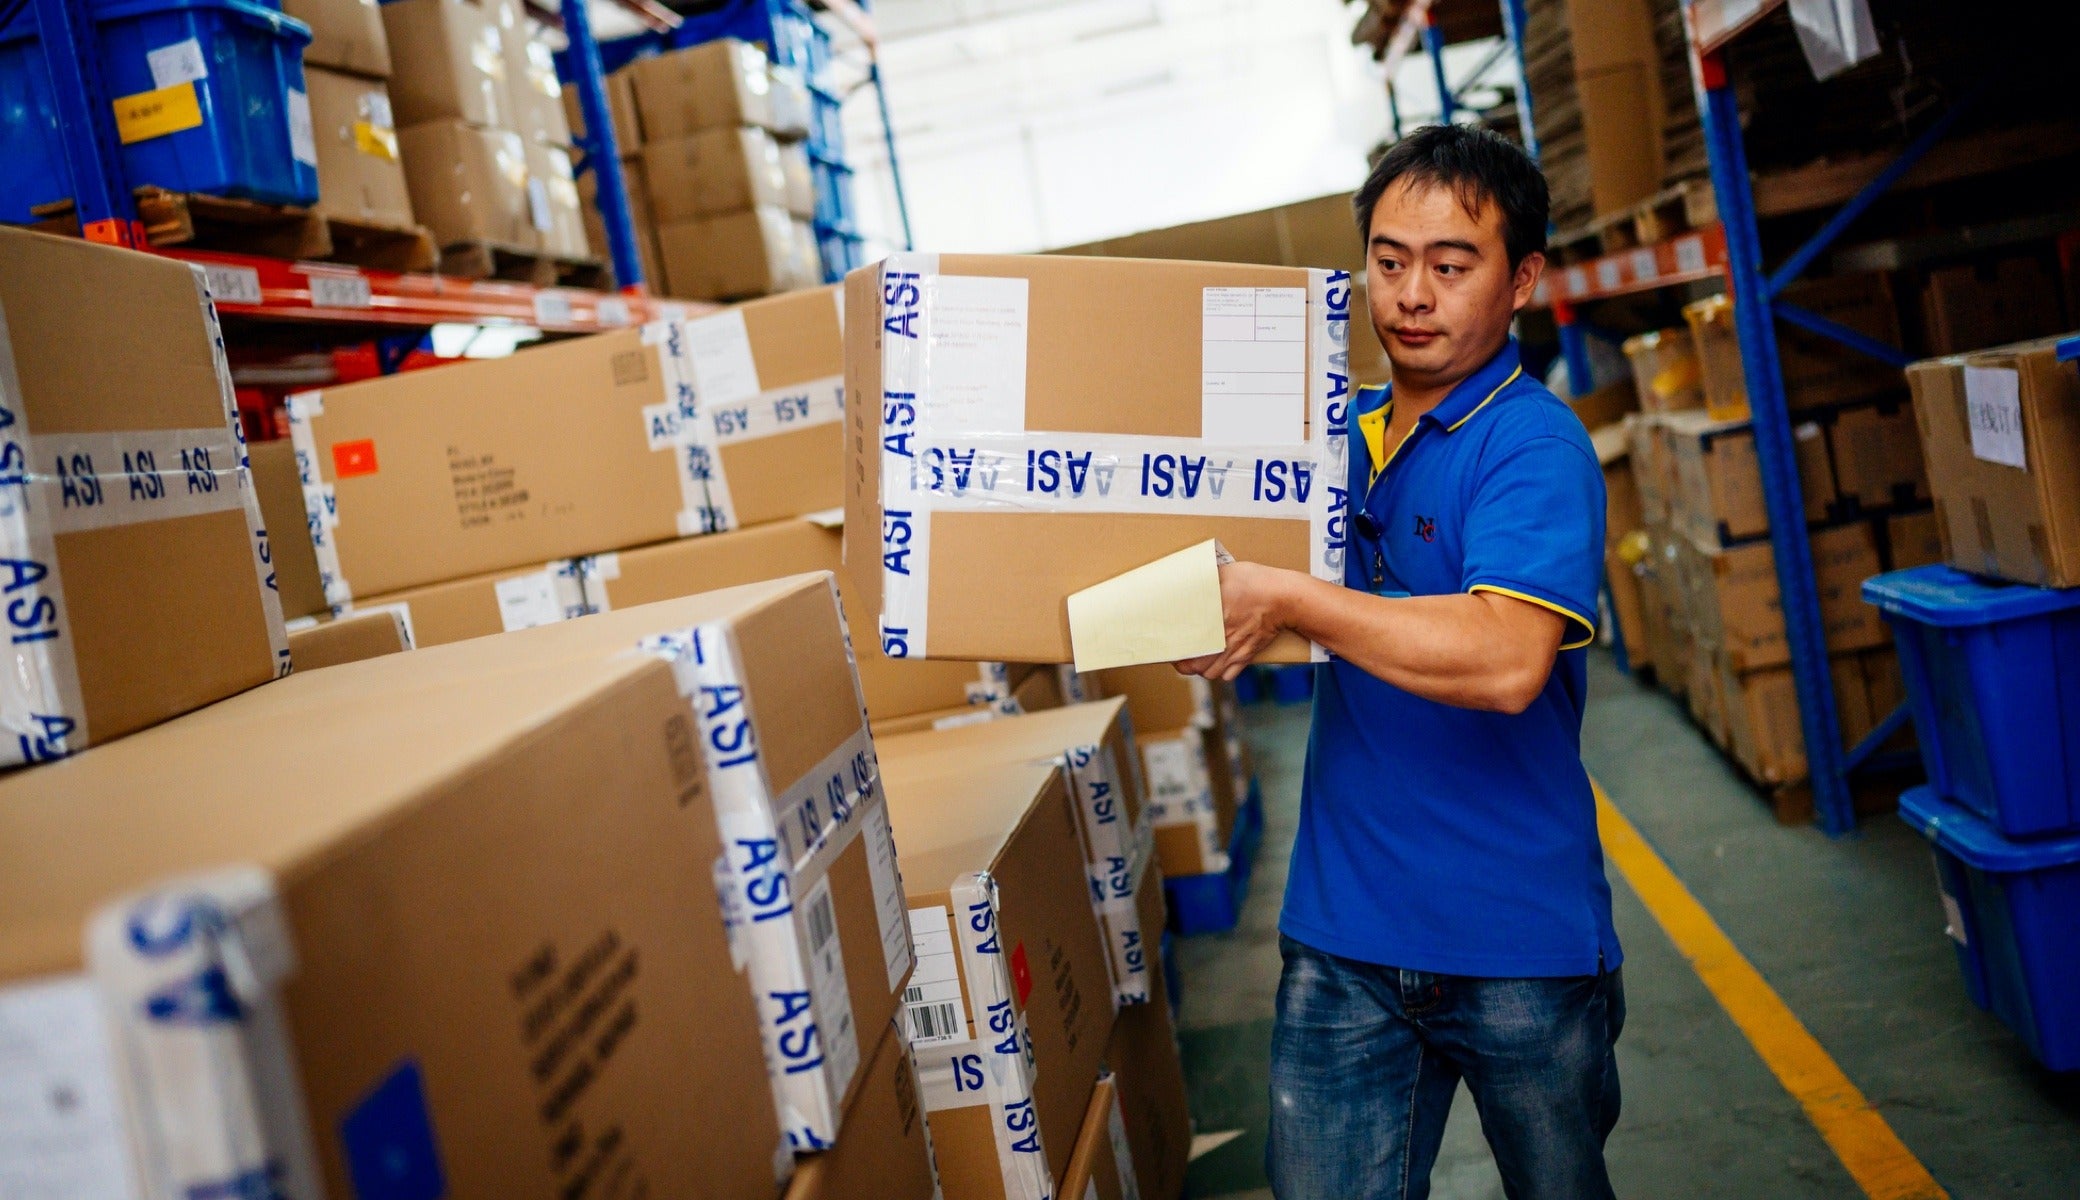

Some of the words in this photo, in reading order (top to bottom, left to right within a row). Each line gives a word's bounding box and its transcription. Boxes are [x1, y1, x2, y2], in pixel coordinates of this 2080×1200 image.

[884, 272, 920, 339] ASI
[774, 395, 808, 423] ASI
[884, 392, 916, 458] ASI
[57, 454, 104, 508] ASI
[123, 450, 165, 501] ASI
[180, 447, 219, 495] ASI
[1027, 449, 1092, 493] ASI
[1141, 454, 1206, 499] ASI
[1254, 459, 1311, 503] ASI
[883, 509, 912, 576] ASI
[0, 558, 58, 645] ASI
[700, 685, 758, 768] ASI
[735, 838, 793, 923] ASI
[769, 990, 825, 1075] ASI
[1089, 781, 1116, 824] ASI
[1107, 856, 1133, 898] ASI
[1121, 930, 1145, 974] ASI
[969, 900, 1000, 953] ASI
[987, 998, 1020, 1054] ASI
[1005, 1097, 1041, 1153] ASI
